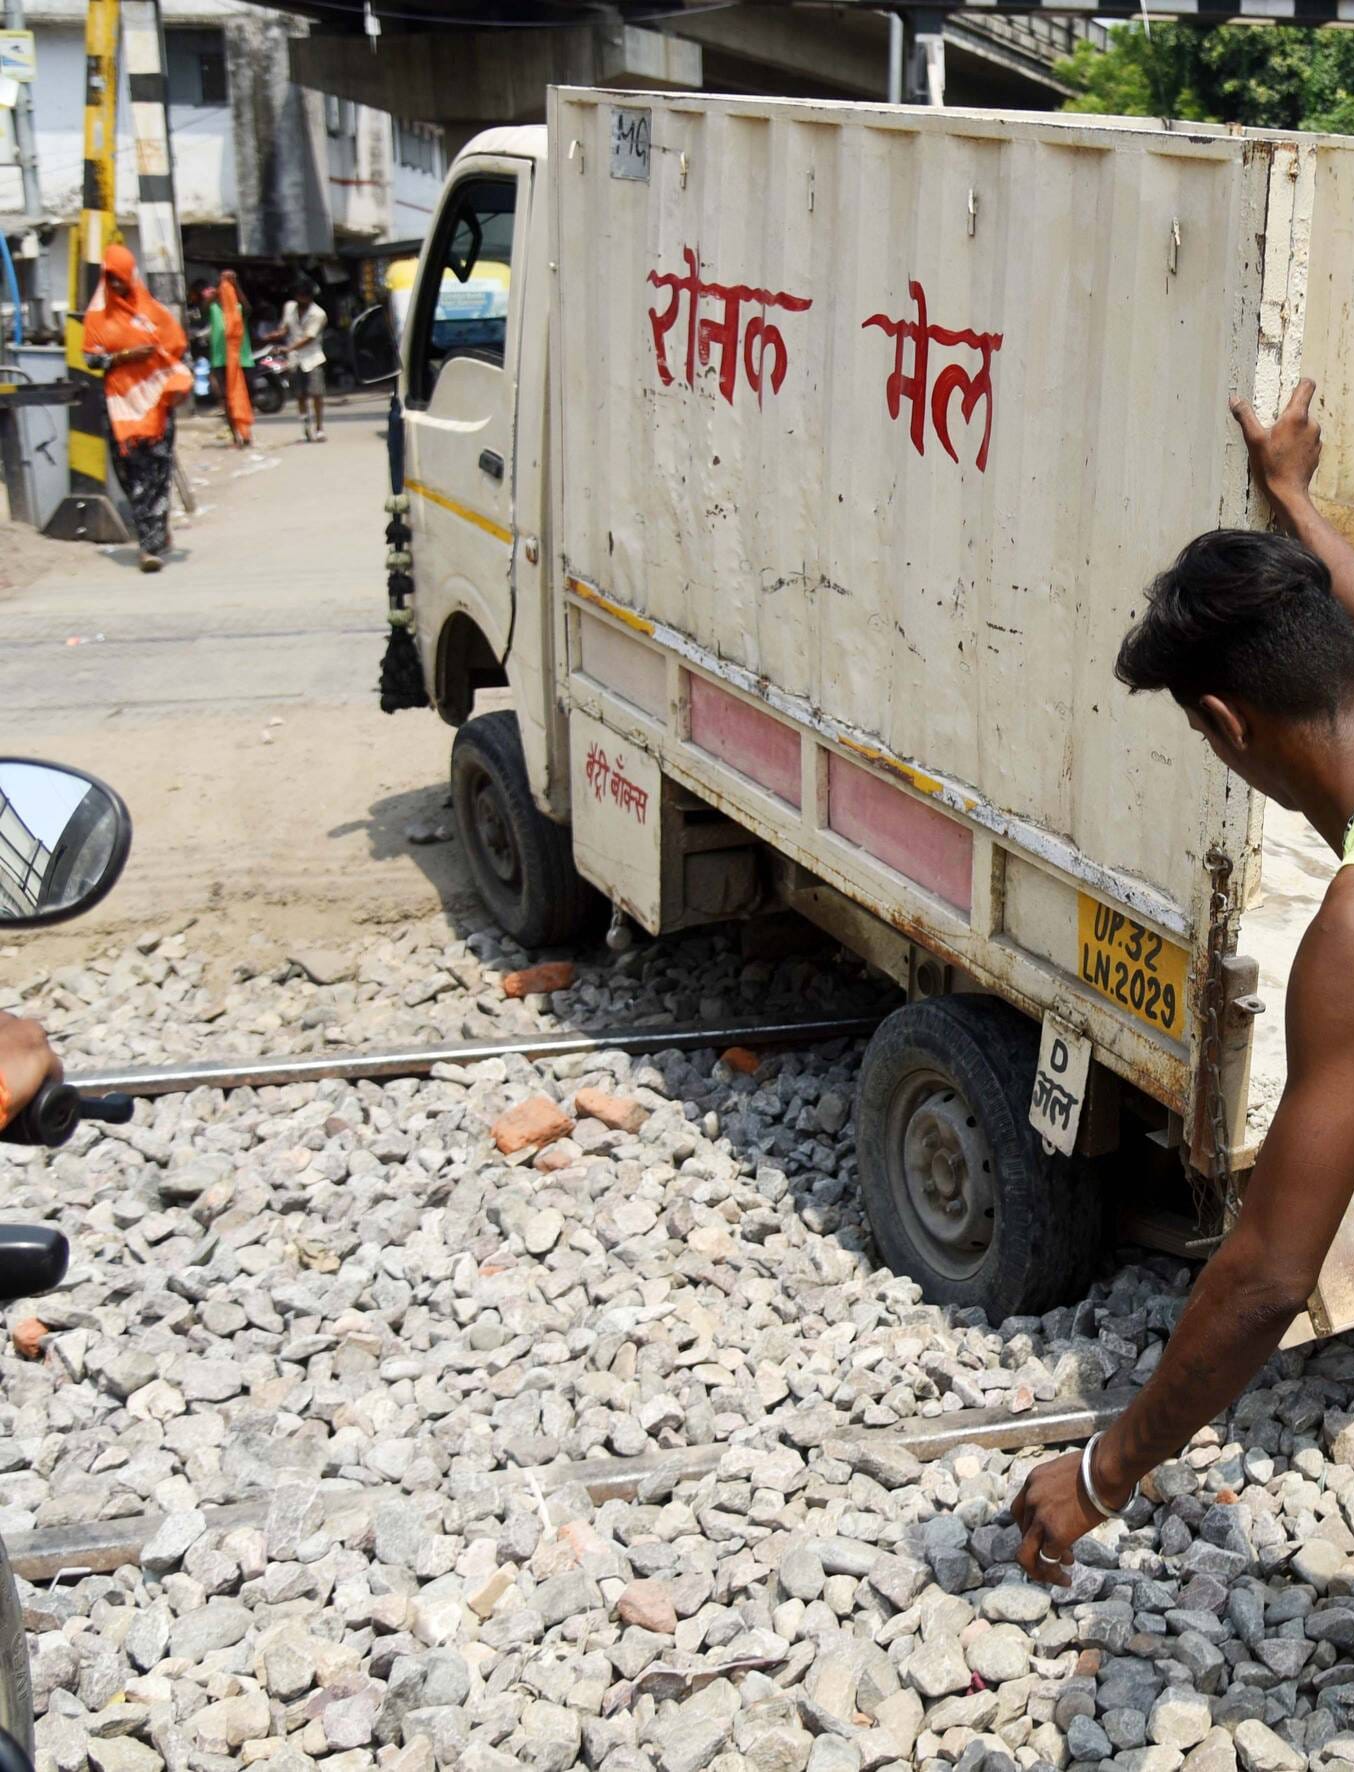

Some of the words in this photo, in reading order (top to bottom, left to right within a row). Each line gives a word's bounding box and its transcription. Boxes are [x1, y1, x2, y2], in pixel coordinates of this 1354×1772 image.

[1083, 942, 1176, 1030] LN.2029
[1051, 1038, 1069, 1074] D
[1033, 1070, 1079, 1131] जल
